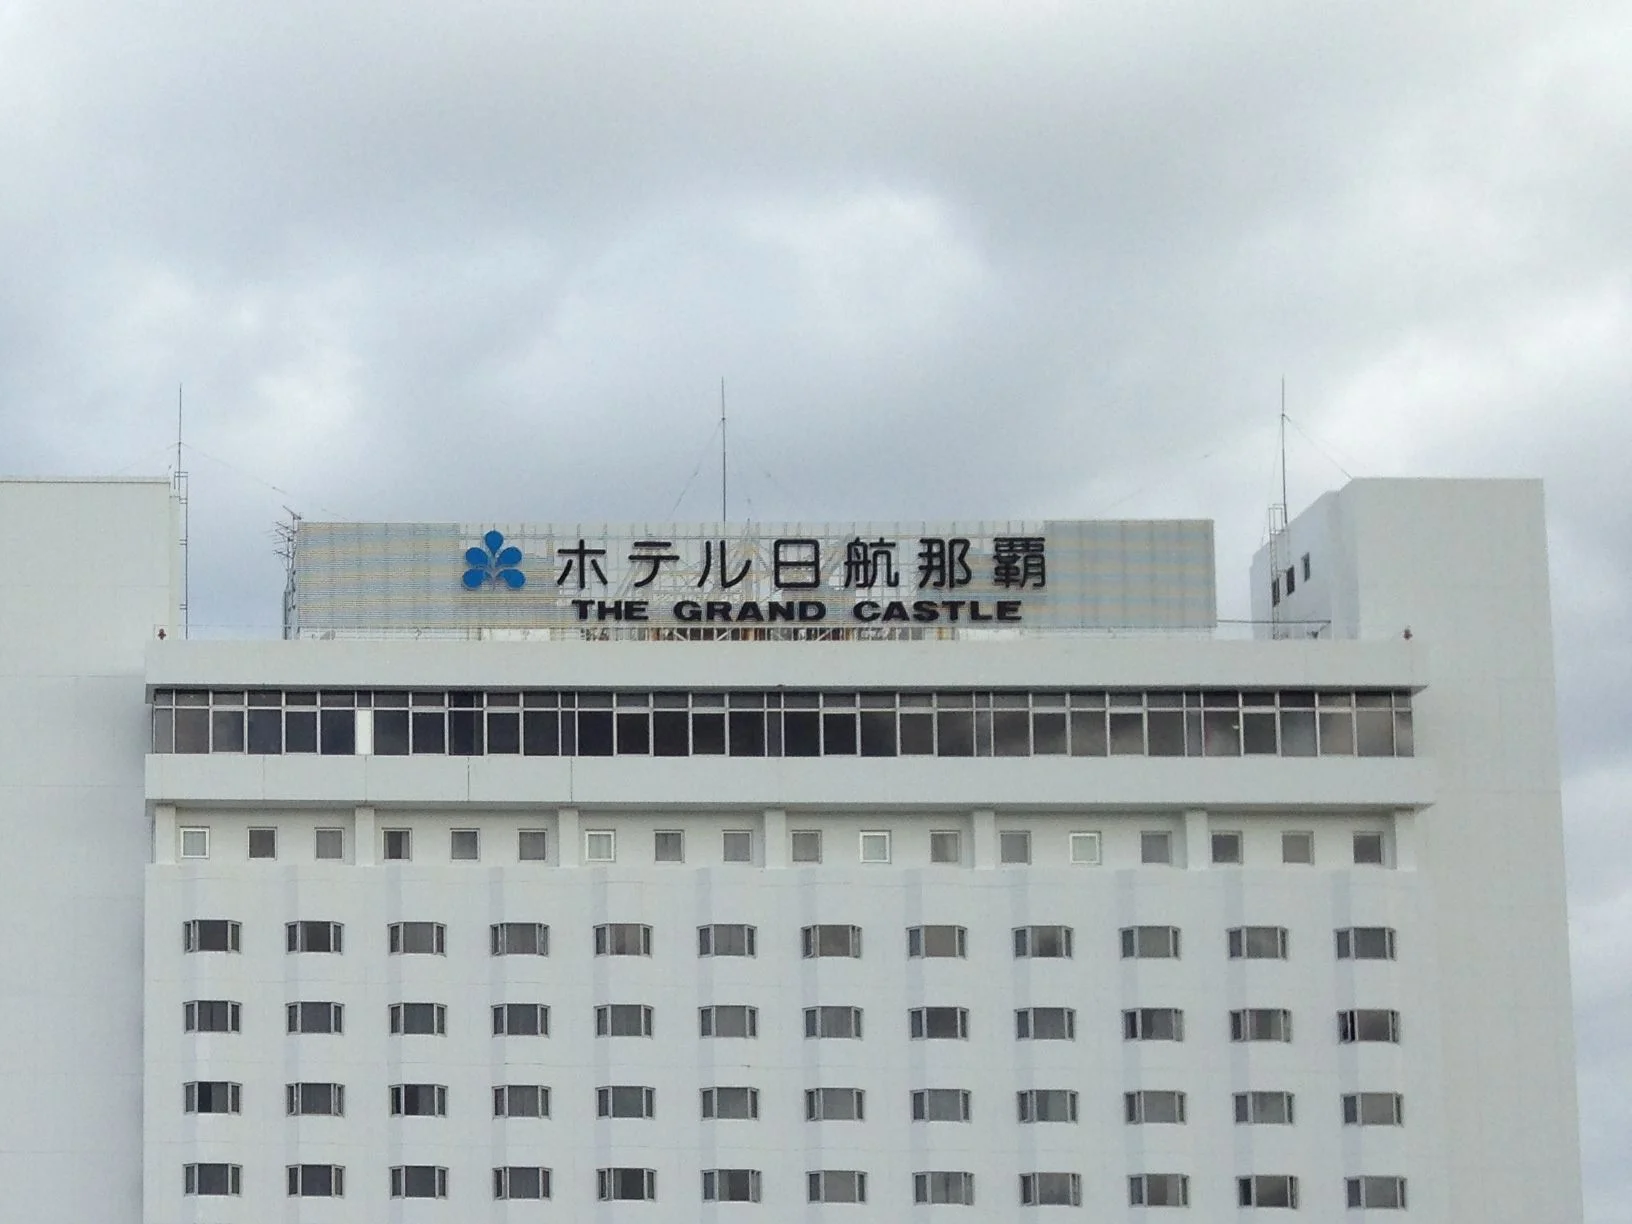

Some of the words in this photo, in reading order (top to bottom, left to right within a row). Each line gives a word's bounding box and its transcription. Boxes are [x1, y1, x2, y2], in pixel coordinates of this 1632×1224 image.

[556, 537, 1046, 589] ホテル日航那覇
[571, 599, 649, 621] THE
[672, 599, 827, 622] GRAND
[853, 600, 1023, 622] CASTLE
